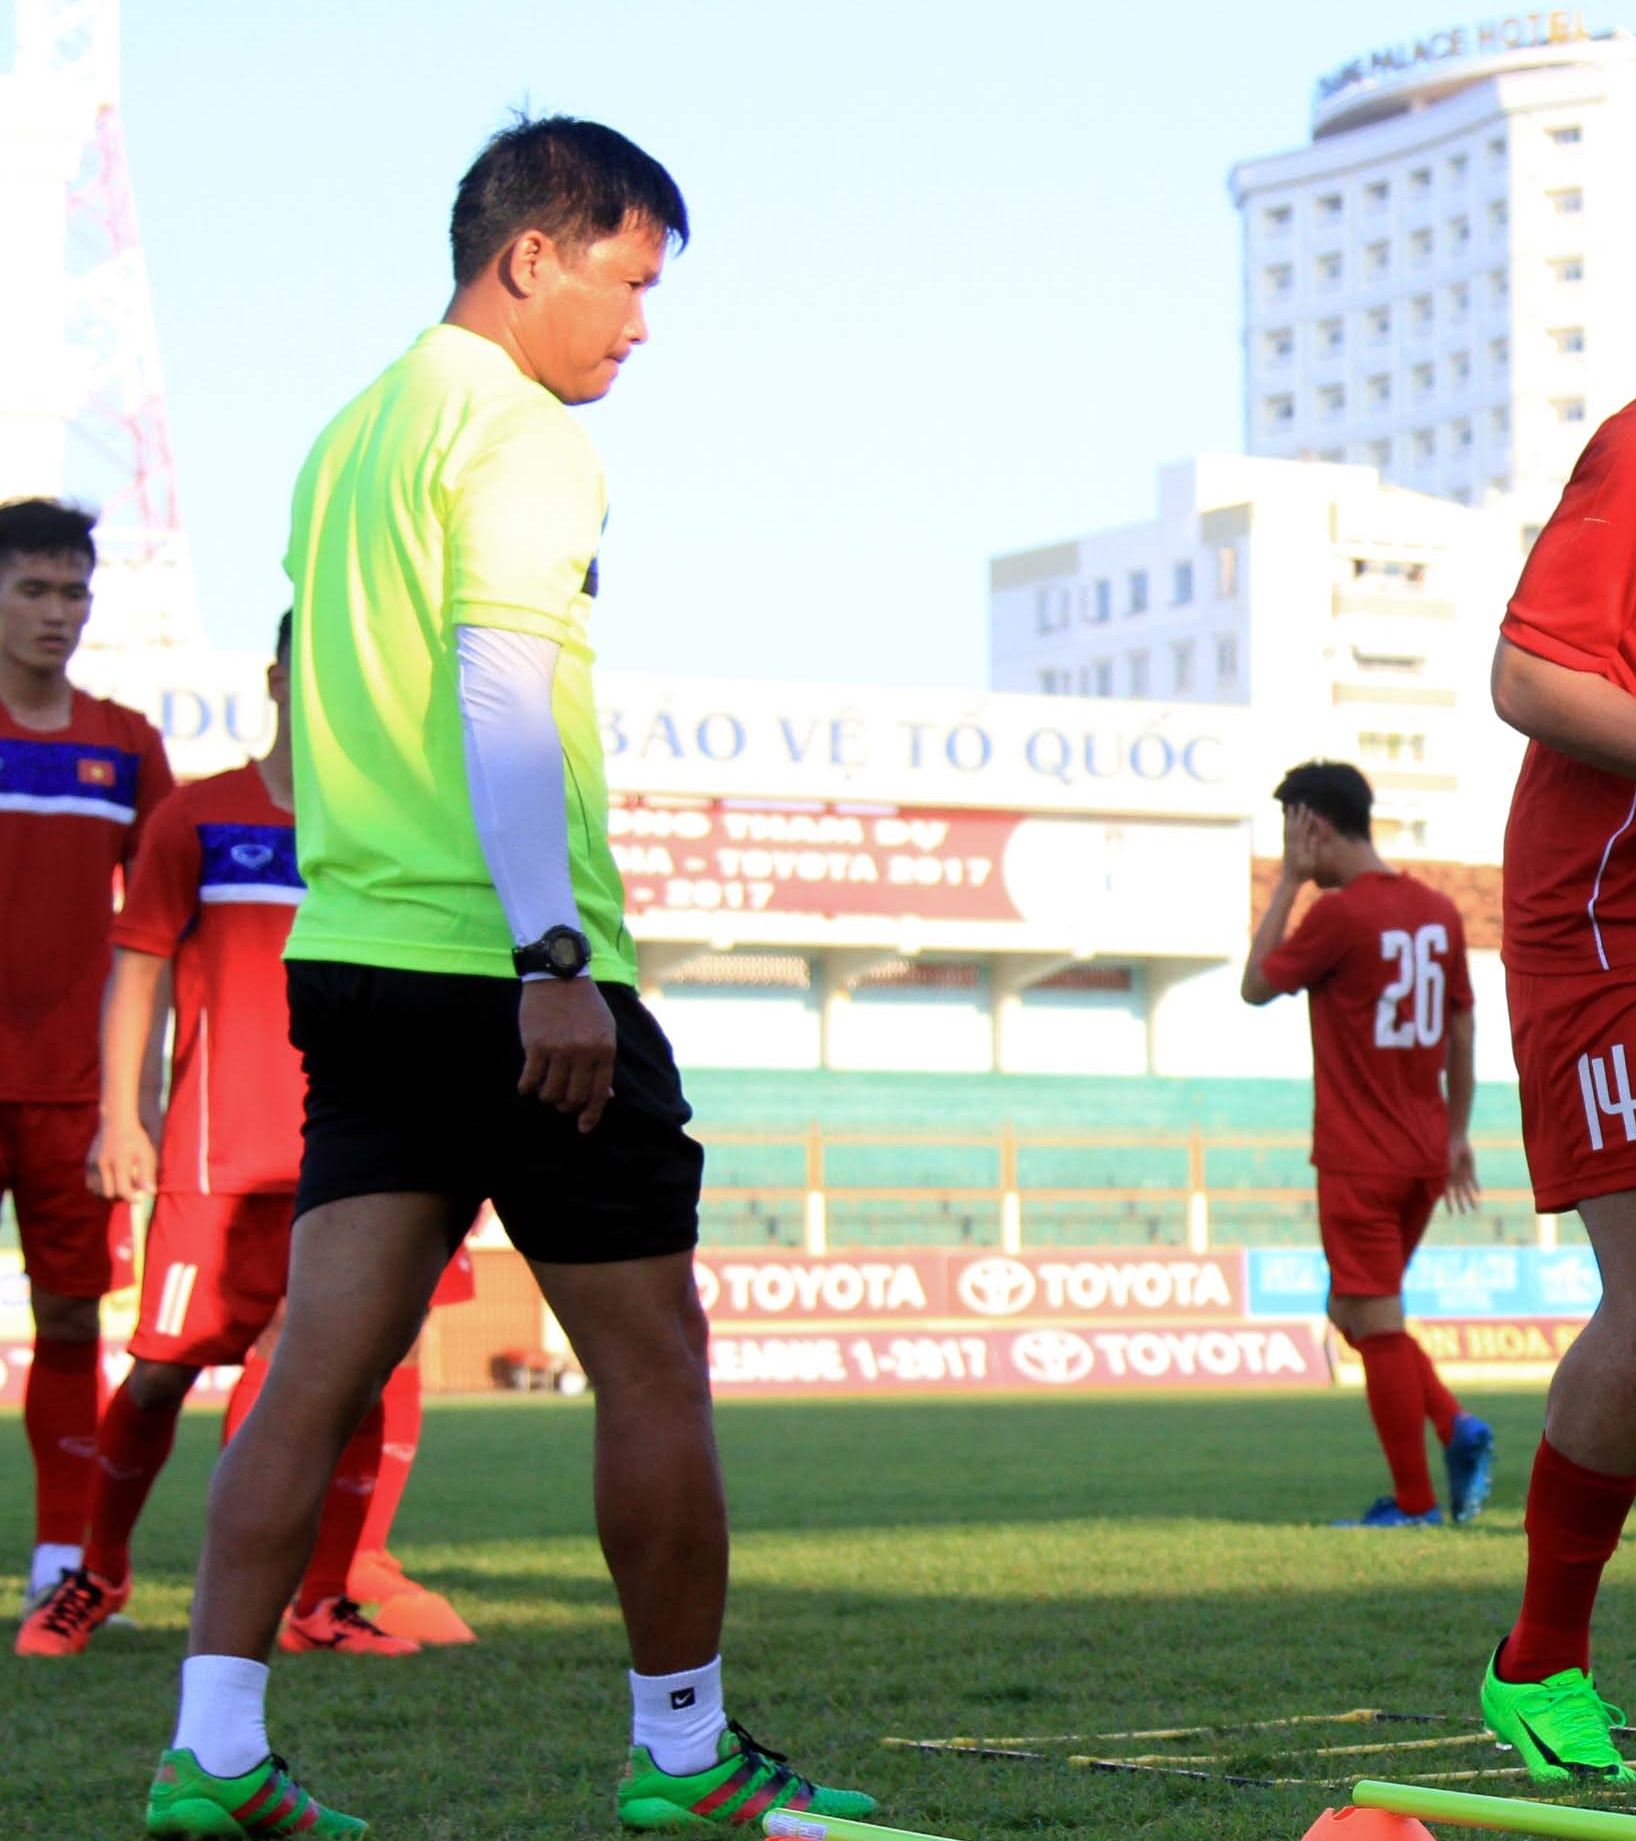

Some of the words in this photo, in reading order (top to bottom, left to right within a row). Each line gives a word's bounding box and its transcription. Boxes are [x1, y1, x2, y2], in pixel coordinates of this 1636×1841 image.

[1476, 9, 1589, 56] HOTEL
[716, 847, 880, 883] TOYOTA
[888, 854, 992, 888] 2017
[665, 878, 774, 910] 2017
[1374, 923, 1449, 1049] 26
[155, 1261, 199, 1338] 11
[723, 1264, 926, 1311] TOYOTA
[1038, 1262, 1232, 1309] TOYOTA
[849, 1338, 987, 1380] 1-2017
[1094, 1330, 1307, 1375] TOYOTA
